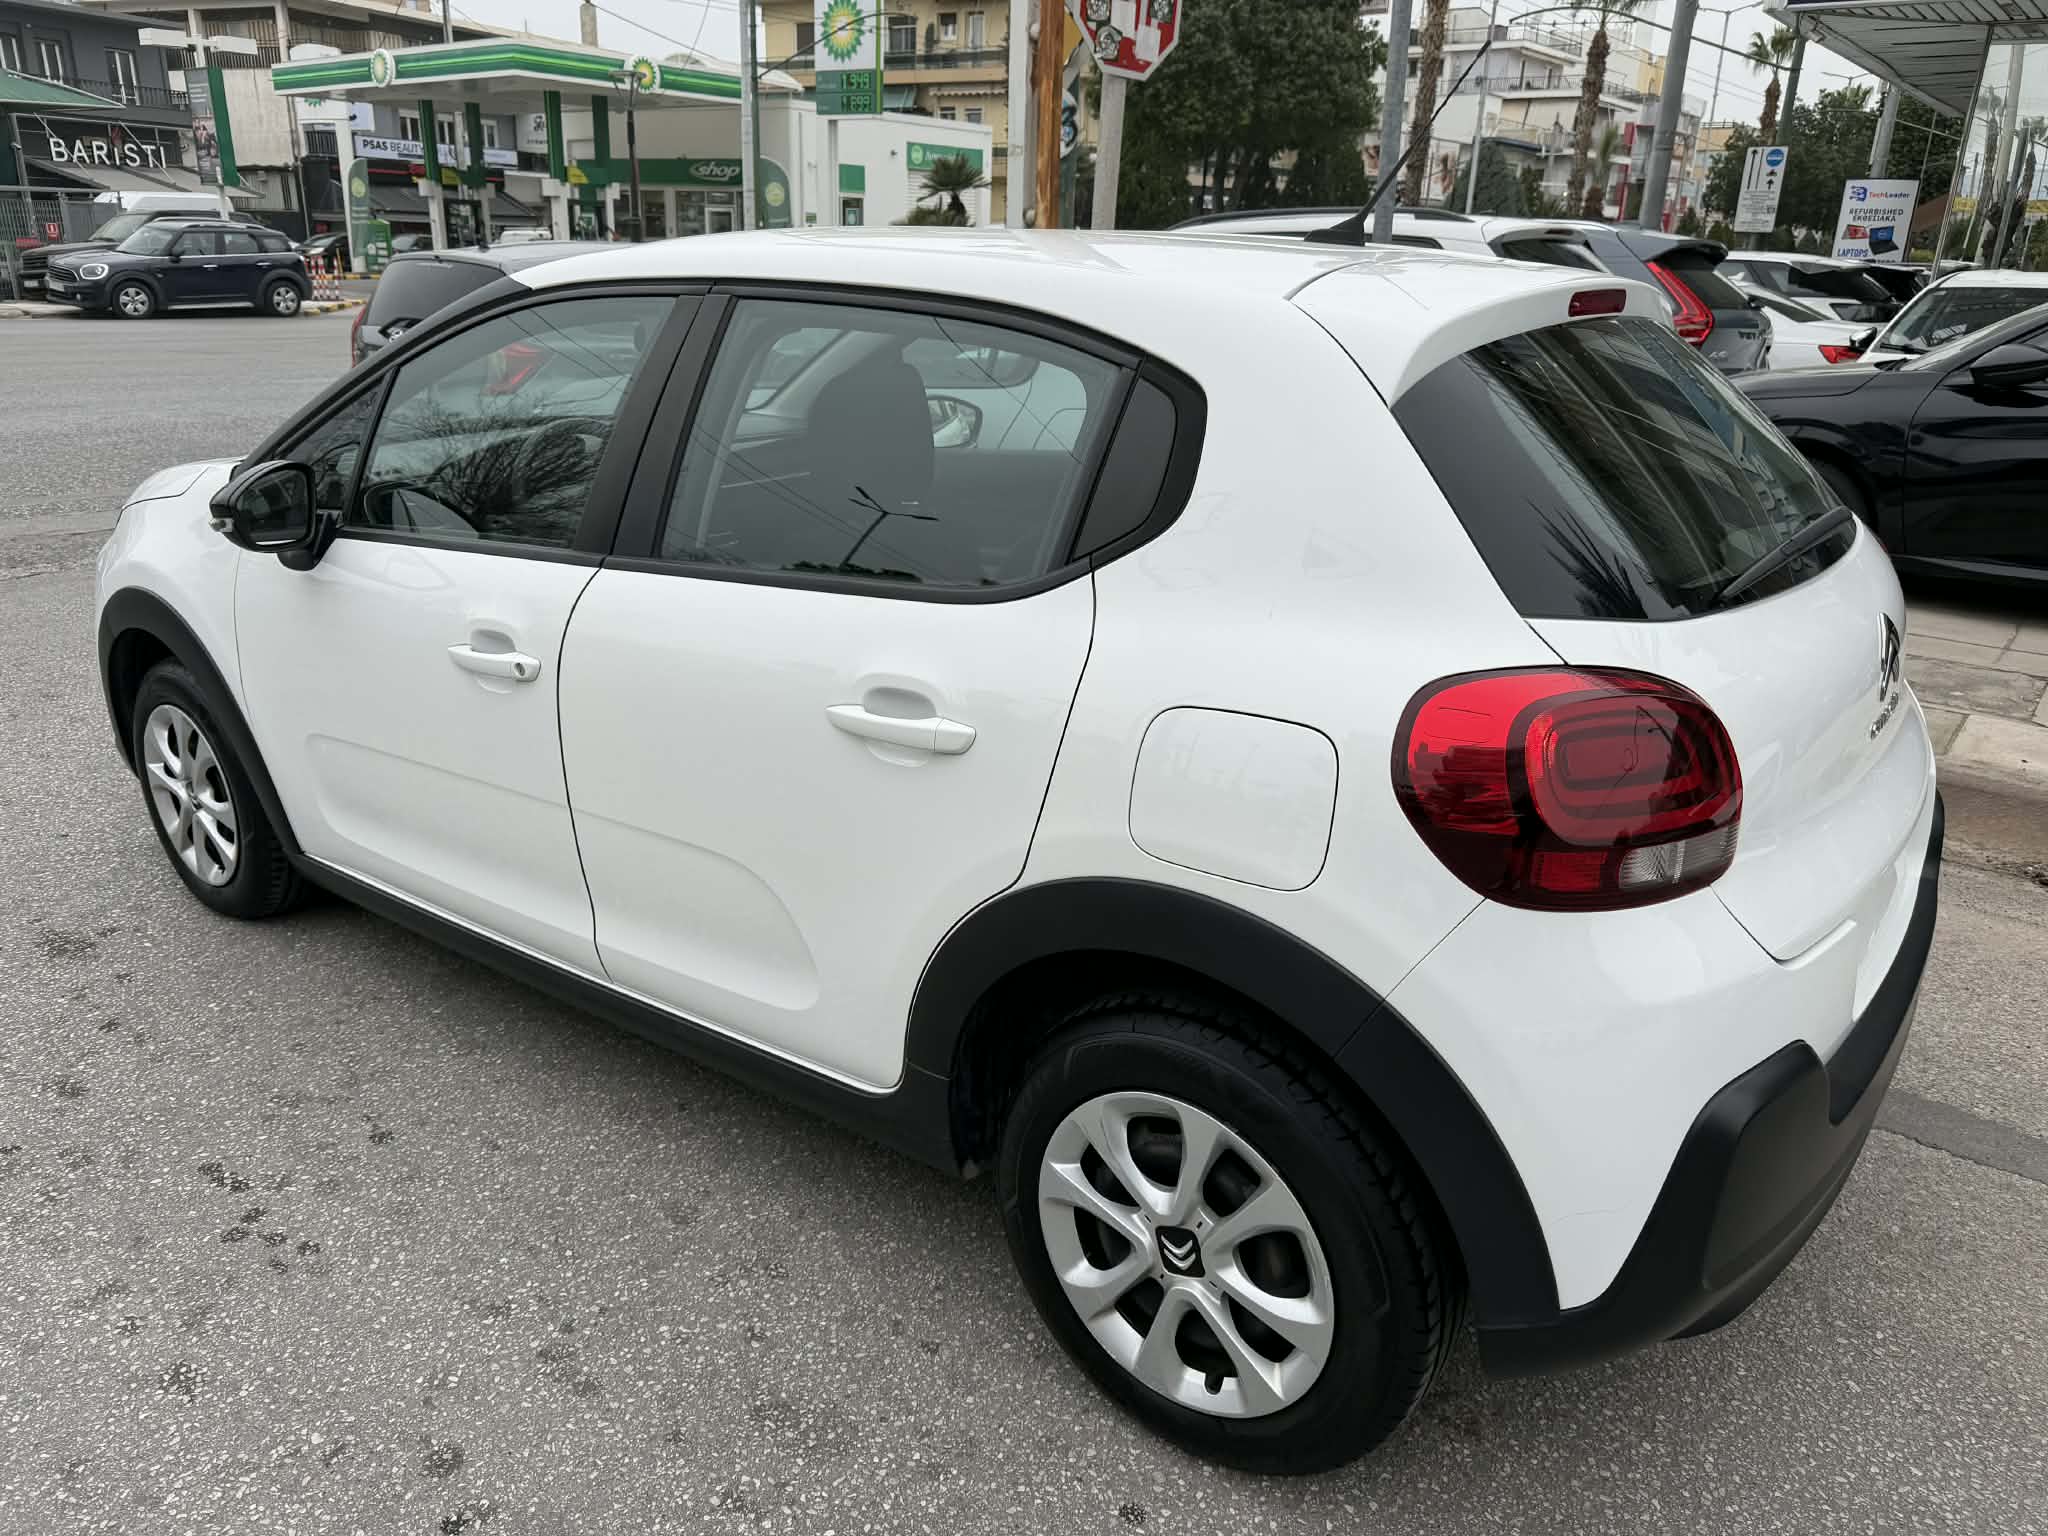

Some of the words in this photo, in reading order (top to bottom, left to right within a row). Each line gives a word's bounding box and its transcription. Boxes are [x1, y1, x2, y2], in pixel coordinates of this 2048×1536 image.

[362, 139, 389, 151] PSAS
[49, 137, 167, 169] BARISTI
[698, 161, 741, 181] shop
[1848, 207, 1904, 216] REFURBISHED
[1836, 247, 1869, 257] LAPTOPS
